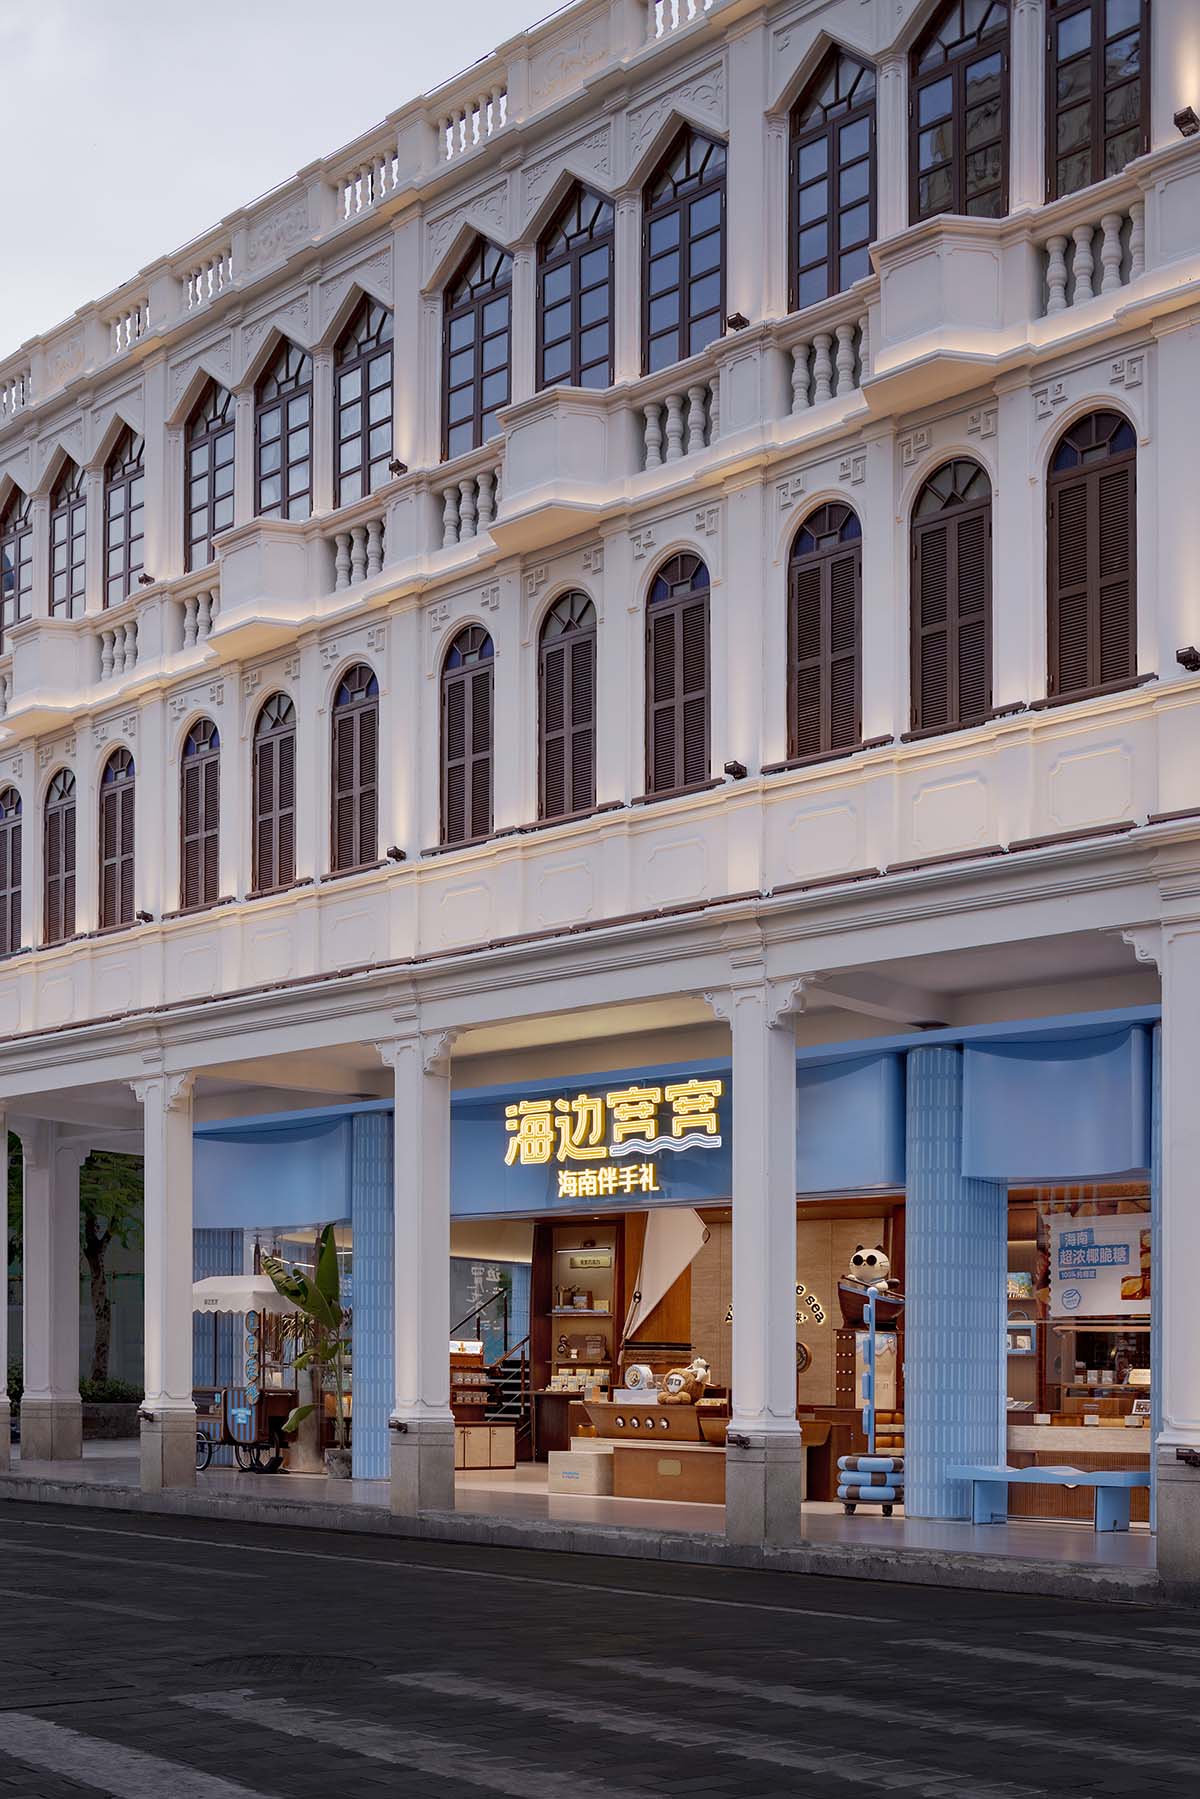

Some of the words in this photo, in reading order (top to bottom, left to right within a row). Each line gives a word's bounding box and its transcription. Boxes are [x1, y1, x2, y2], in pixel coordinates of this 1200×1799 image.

[557, 1163, 660, 1198] 海南伴手礼
[1063, 1232, 1089, 1247] 海南
[804, 1295, 826, 1325] sea
